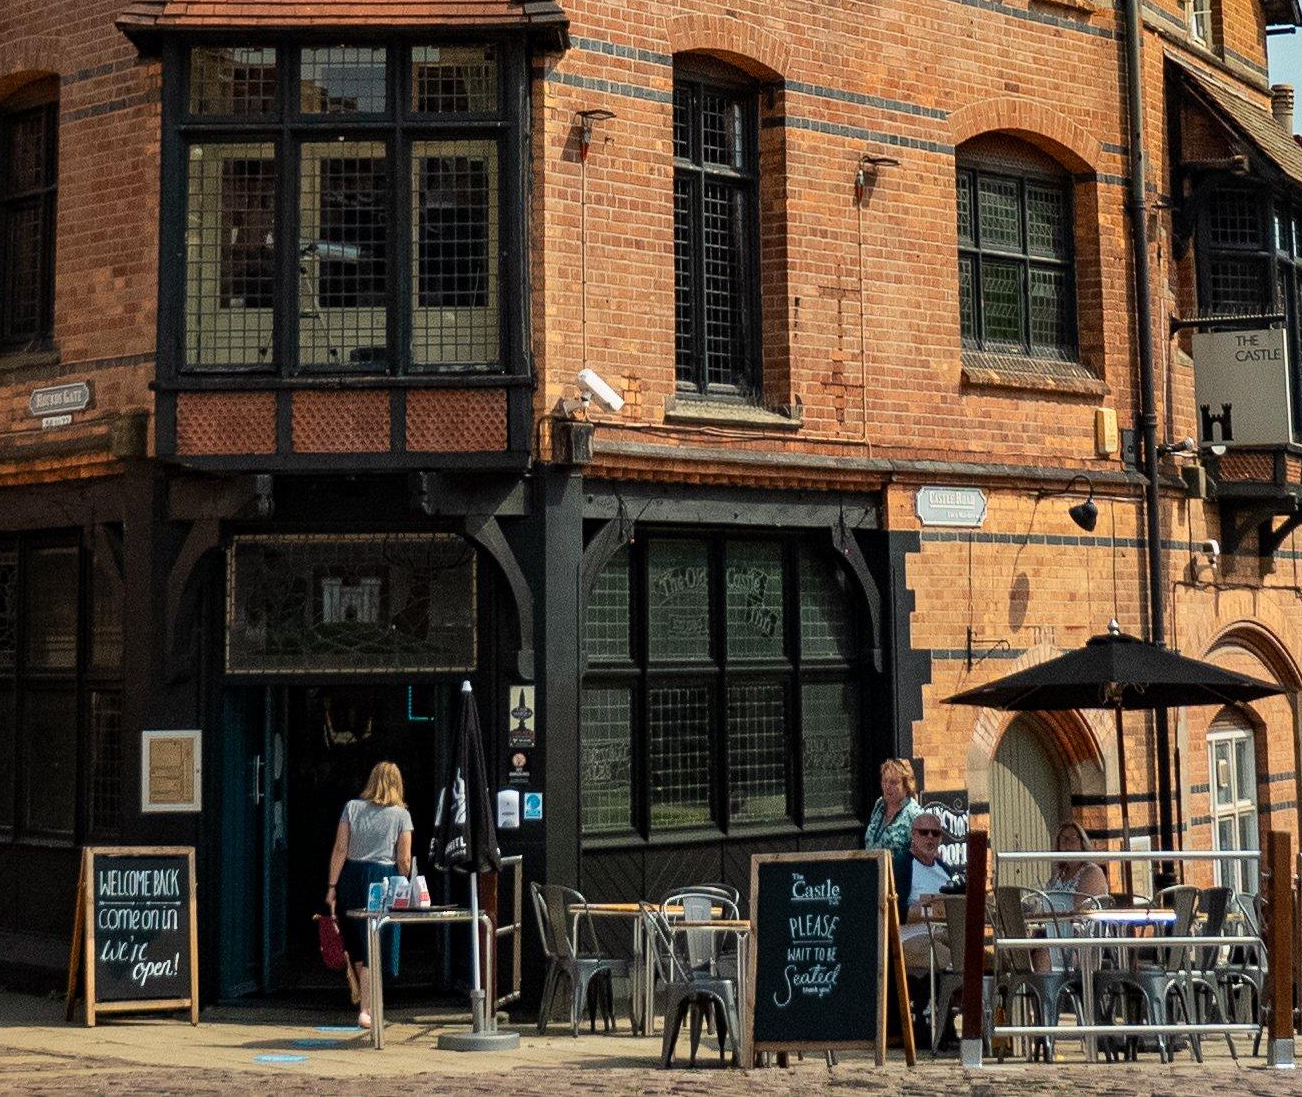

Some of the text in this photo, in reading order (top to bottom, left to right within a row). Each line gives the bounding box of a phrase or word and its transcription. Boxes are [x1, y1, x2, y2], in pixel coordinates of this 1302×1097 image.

[1235, 335, 1258, 346] THE
[1235, 349, 1281, 362] CASTLE
[929, 492, 954, 504] CASTLE
[99, 869, 180, 896] WELCOME BACK
[792, 878, 840, 898] Castle
[99, 905, 178, 930] come on in
[789, 914, 840, 939] PLEASE
[787, 946, 838, 961] WAIT TO BE
[132, 952, 180, 987] open!
[773, 961, 841, 1007] Seated
